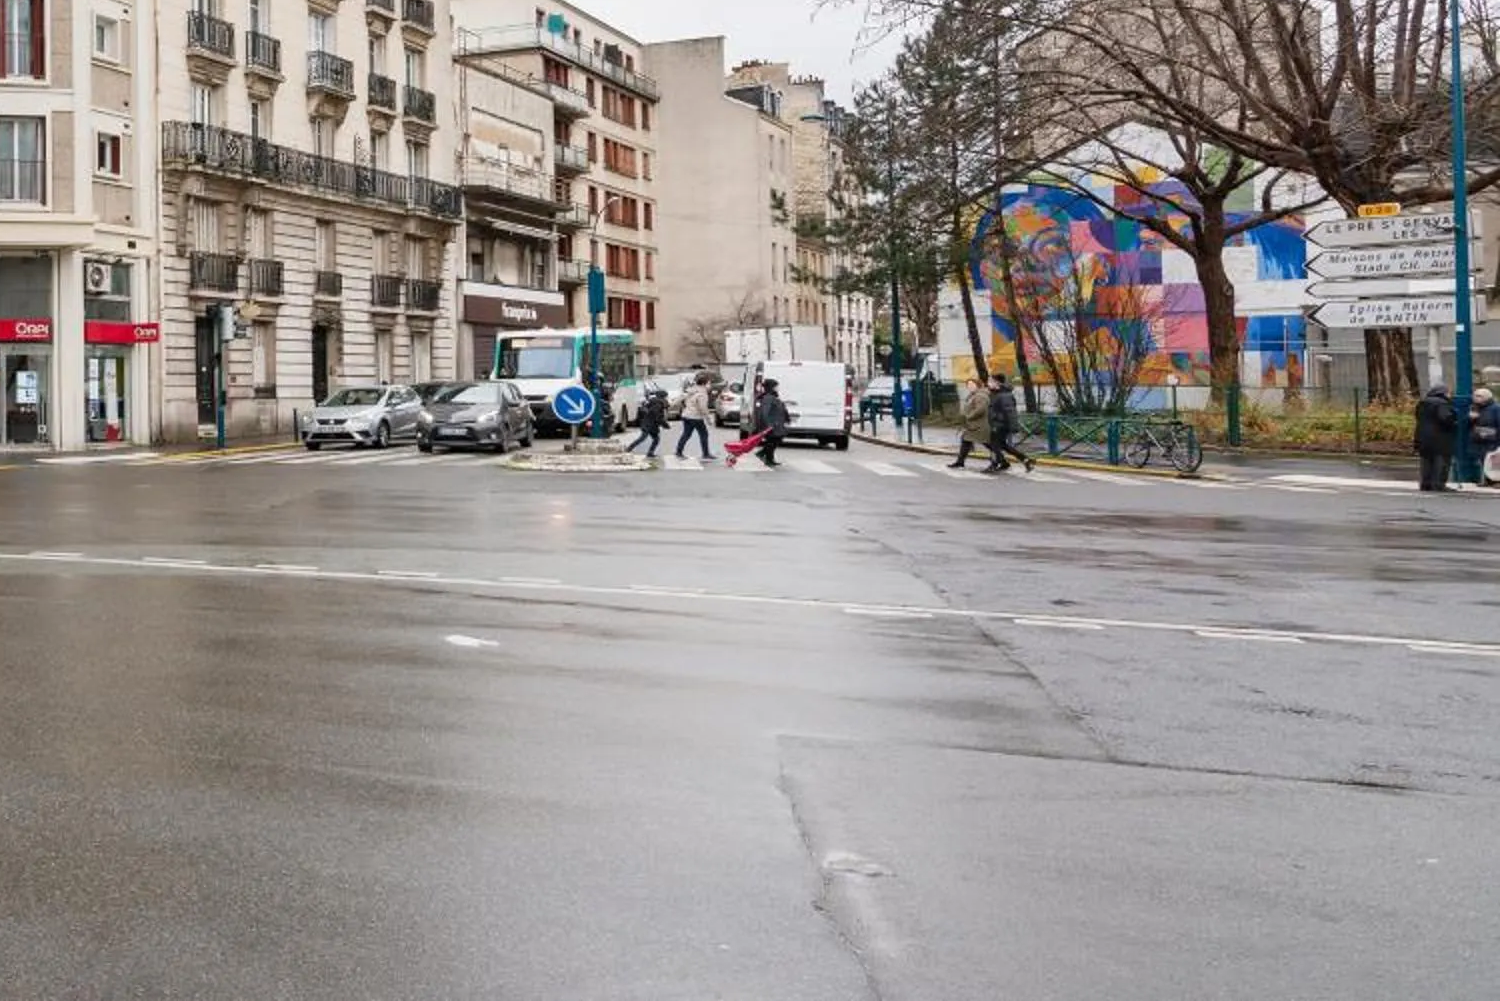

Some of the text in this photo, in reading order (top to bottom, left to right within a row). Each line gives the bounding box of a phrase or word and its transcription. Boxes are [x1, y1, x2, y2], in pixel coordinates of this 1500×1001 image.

[1325, 224, 1341, 234] LE
[1403, 216, 1452, 228] GERVA
[1329, 253, 1382, 264] Maisons
[1389, 251, 1405, 260] de
[1430, 259, 1454, 268] Aur
[1349, 312, 1429, 324] de PANTIN
